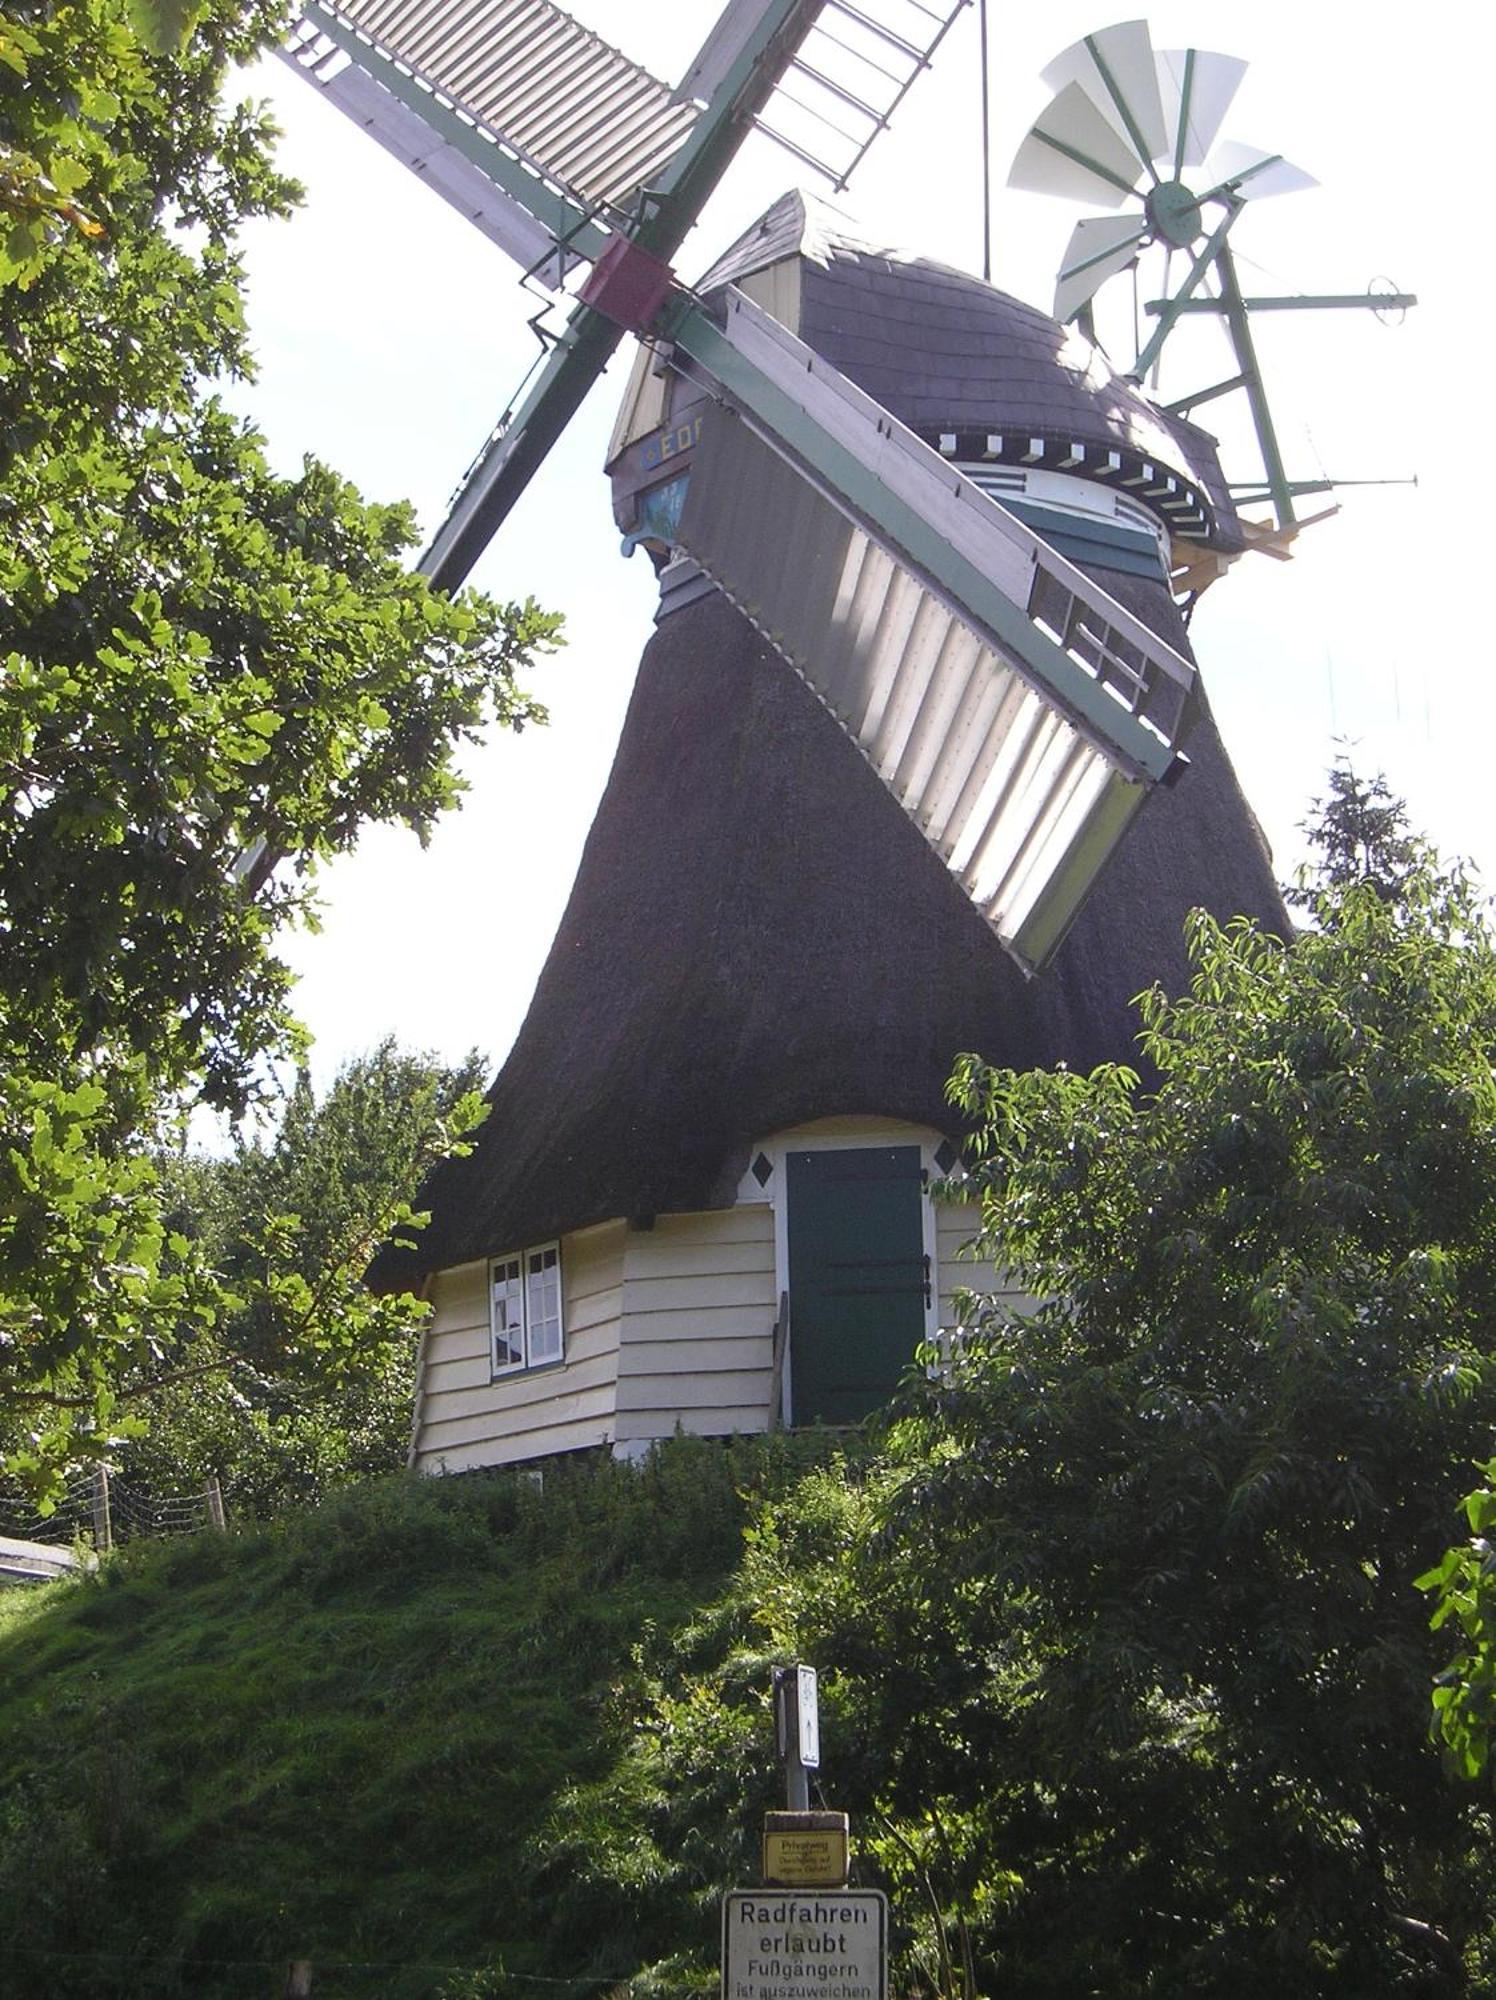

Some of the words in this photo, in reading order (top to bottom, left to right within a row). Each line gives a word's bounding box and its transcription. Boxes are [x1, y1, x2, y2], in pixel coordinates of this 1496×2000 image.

[741, 1902, 868, 1924] Radfahren
[760, 1932, 847, 1953] erlaubt
[748, 1960, 858, 1980] Fußgängern
[736, 1981, 753, 1998] ist
[759, 1983, 871, 1999] auszuweichen
